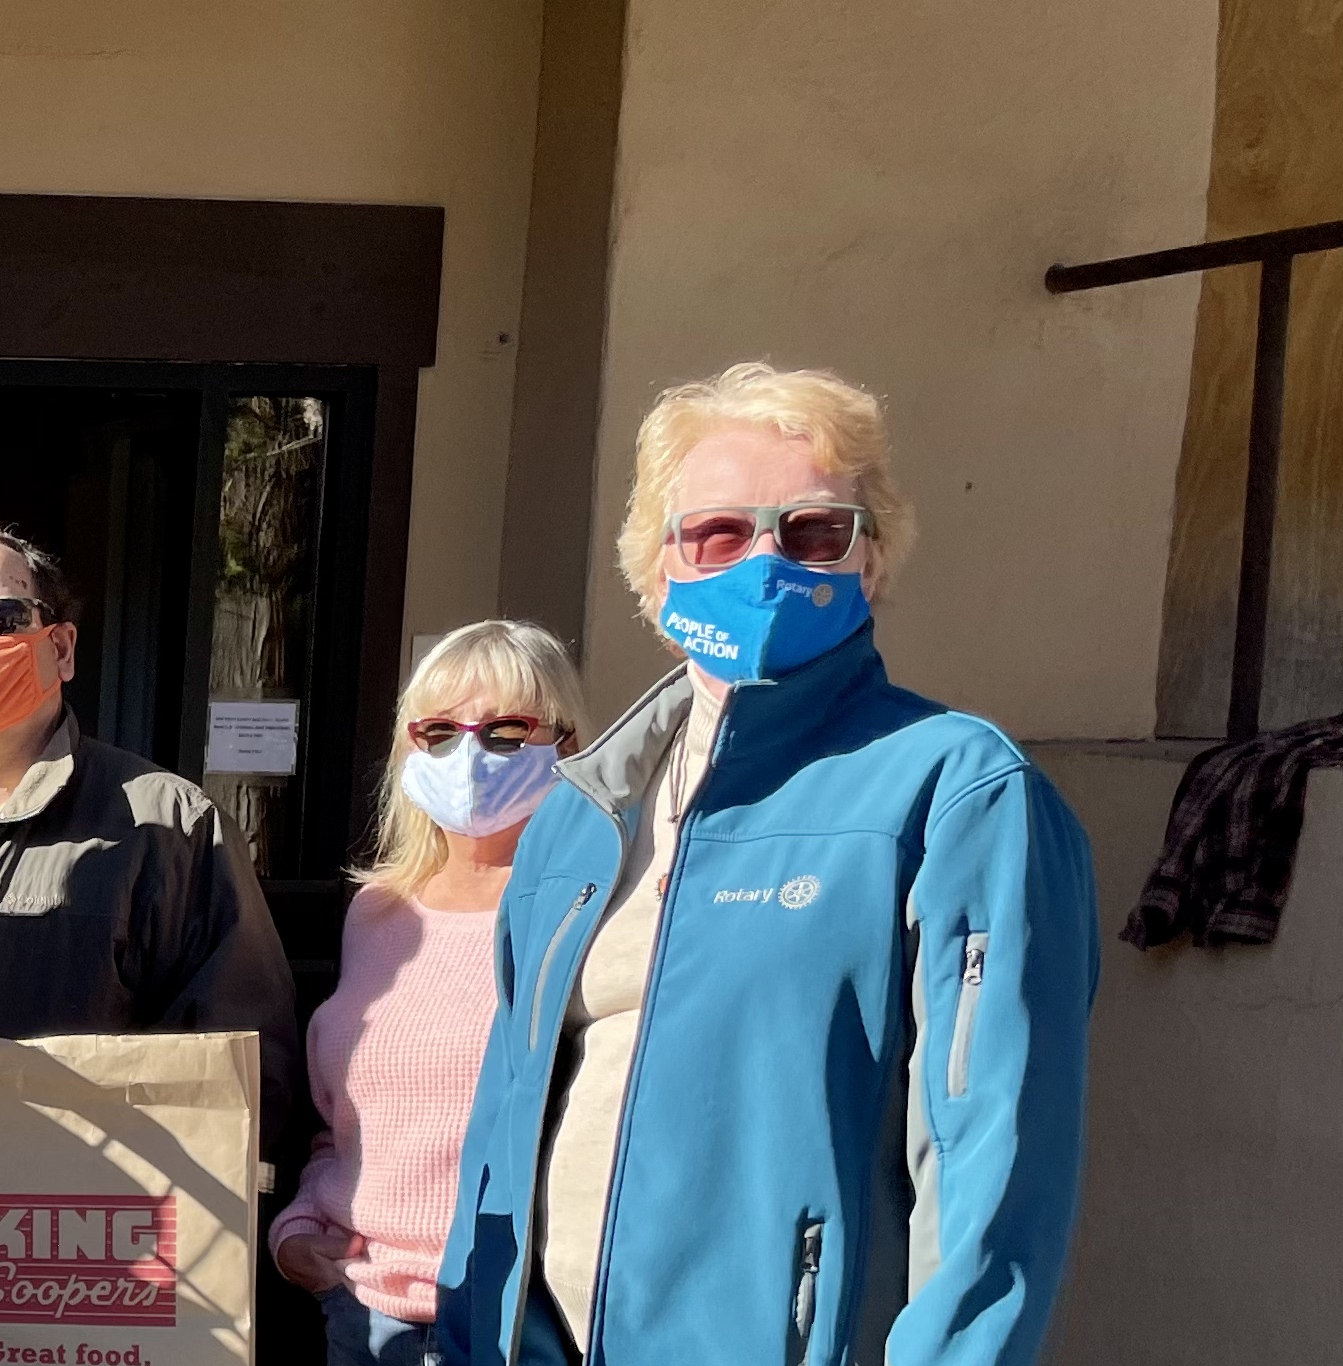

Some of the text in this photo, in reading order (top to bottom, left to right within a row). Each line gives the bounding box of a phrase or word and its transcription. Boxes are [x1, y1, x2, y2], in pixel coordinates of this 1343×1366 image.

[776, 579, 813, 598] Rotary
[666, 611, 730, 643] PEOPLE OF
[682, 636, 740, 661] ACTION
[713, 886, 774, 905] Rotary
[75, 1341, 151, 1366] food.
